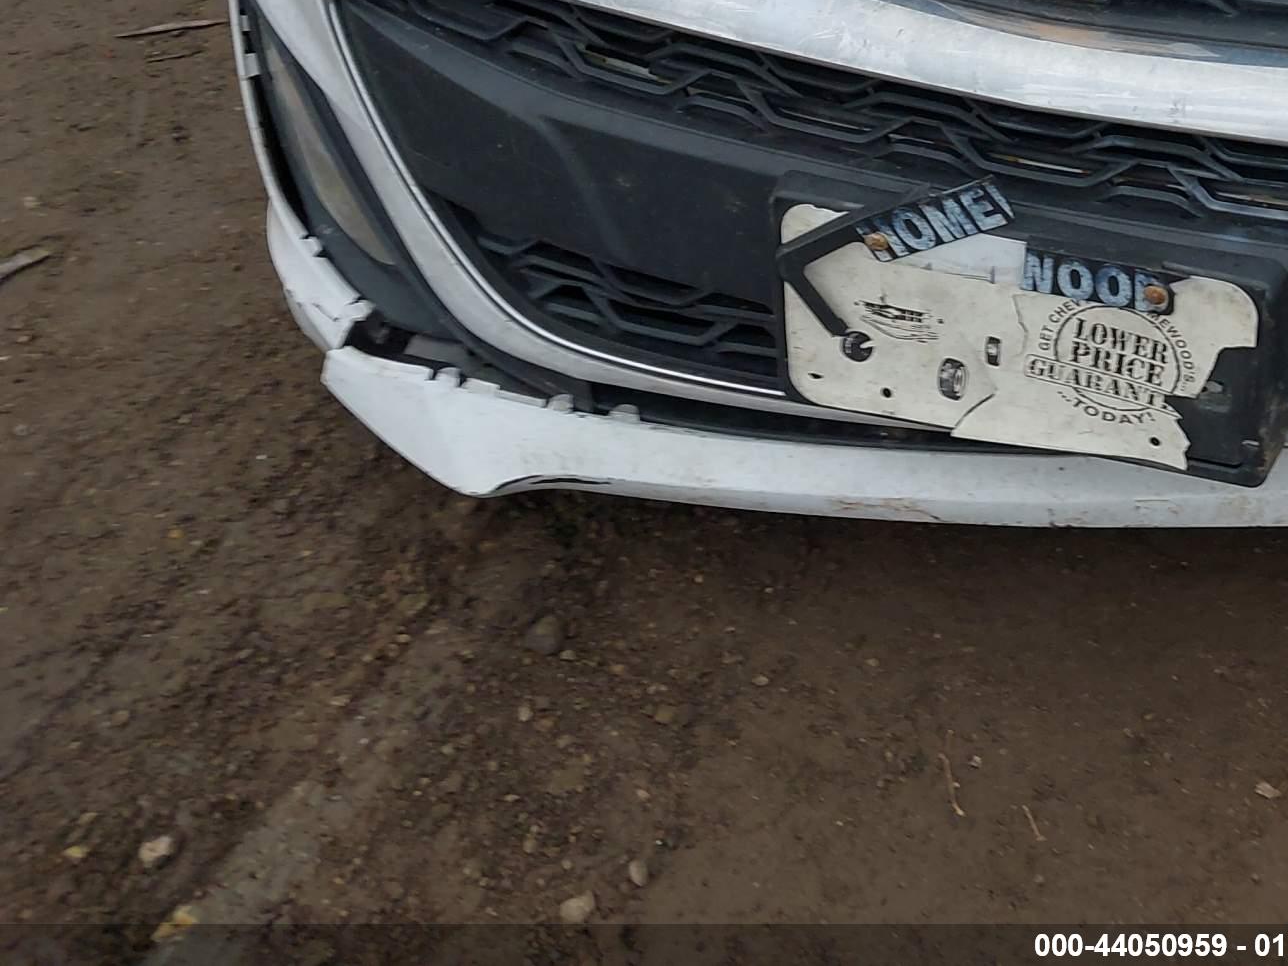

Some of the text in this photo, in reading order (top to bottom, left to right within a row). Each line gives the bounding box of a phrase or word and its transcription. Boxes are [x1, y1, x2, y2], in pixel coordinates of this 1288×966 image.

[856, 182, 1015, 262] HOME
[1070, 340, 1165, 387] PRICE
[1073, 317, 1168, 364] LOWER
[1029, 358, 1168, 409] GUARANT
